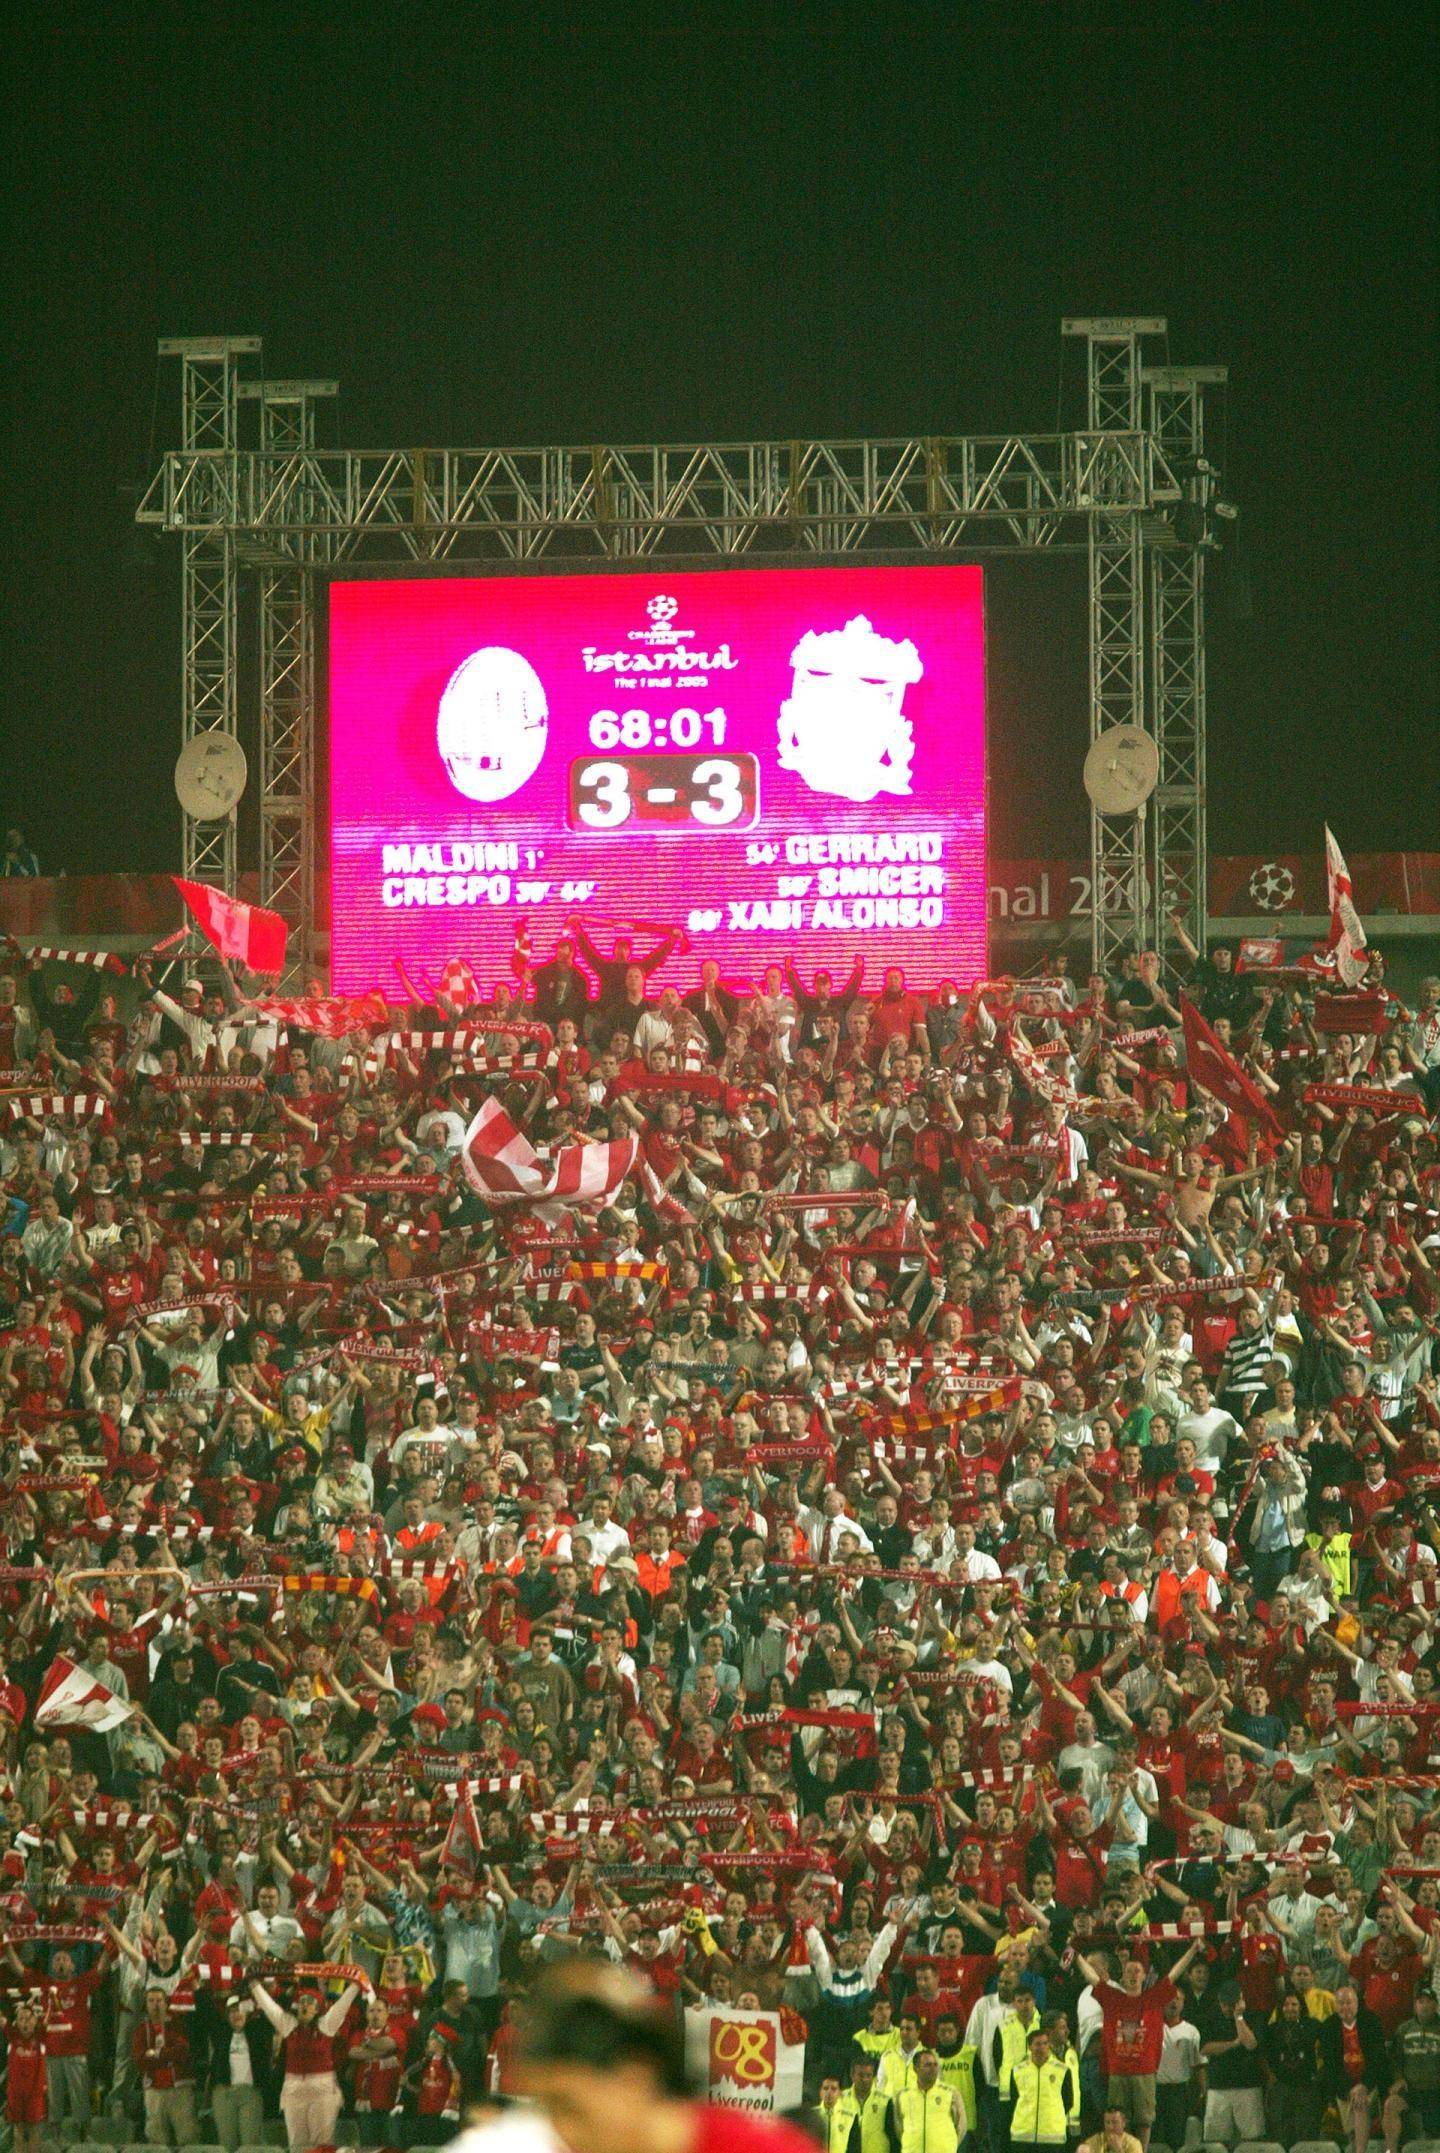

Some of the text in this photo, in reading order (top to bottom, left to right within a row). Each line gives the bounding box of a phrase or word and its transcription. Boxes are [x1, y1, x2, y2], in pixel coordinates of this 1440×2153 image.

[589, 707, 728, 749] 68:01
[382, 842, 519, 873] MALDINI
[786, 833, 943, 864] GERRARD
[382, 875, 511, 907] CRESPO
[728, 900, 802, 931] XABI
[811, 898, 943, 930] ALONSO
